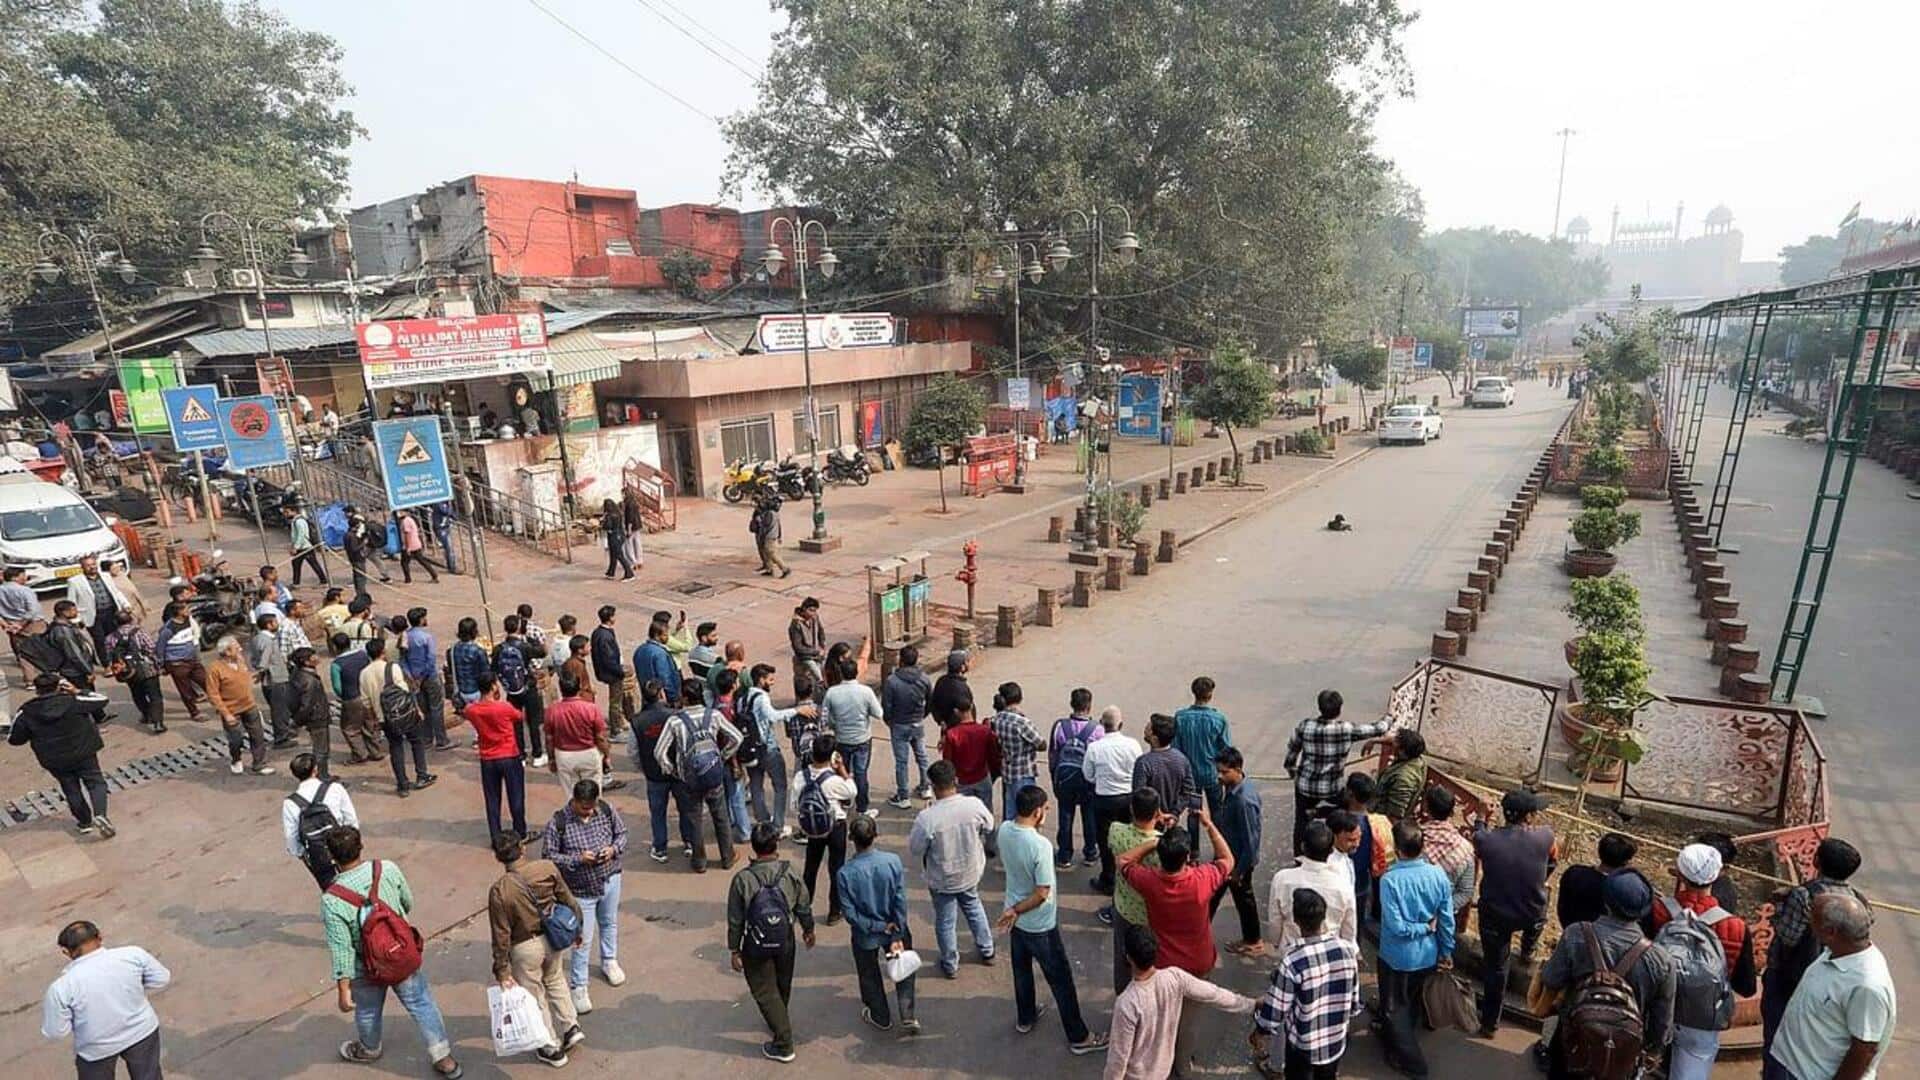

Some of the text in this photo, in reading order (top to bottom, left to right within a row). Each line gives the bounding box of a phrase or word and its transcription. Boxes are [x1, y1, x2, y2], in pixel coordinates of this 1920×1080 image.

[397, 333, 421, 348] OLD
[479, 327, 517, 341] MARKET
[420, 479, 442, 488] CCTV
